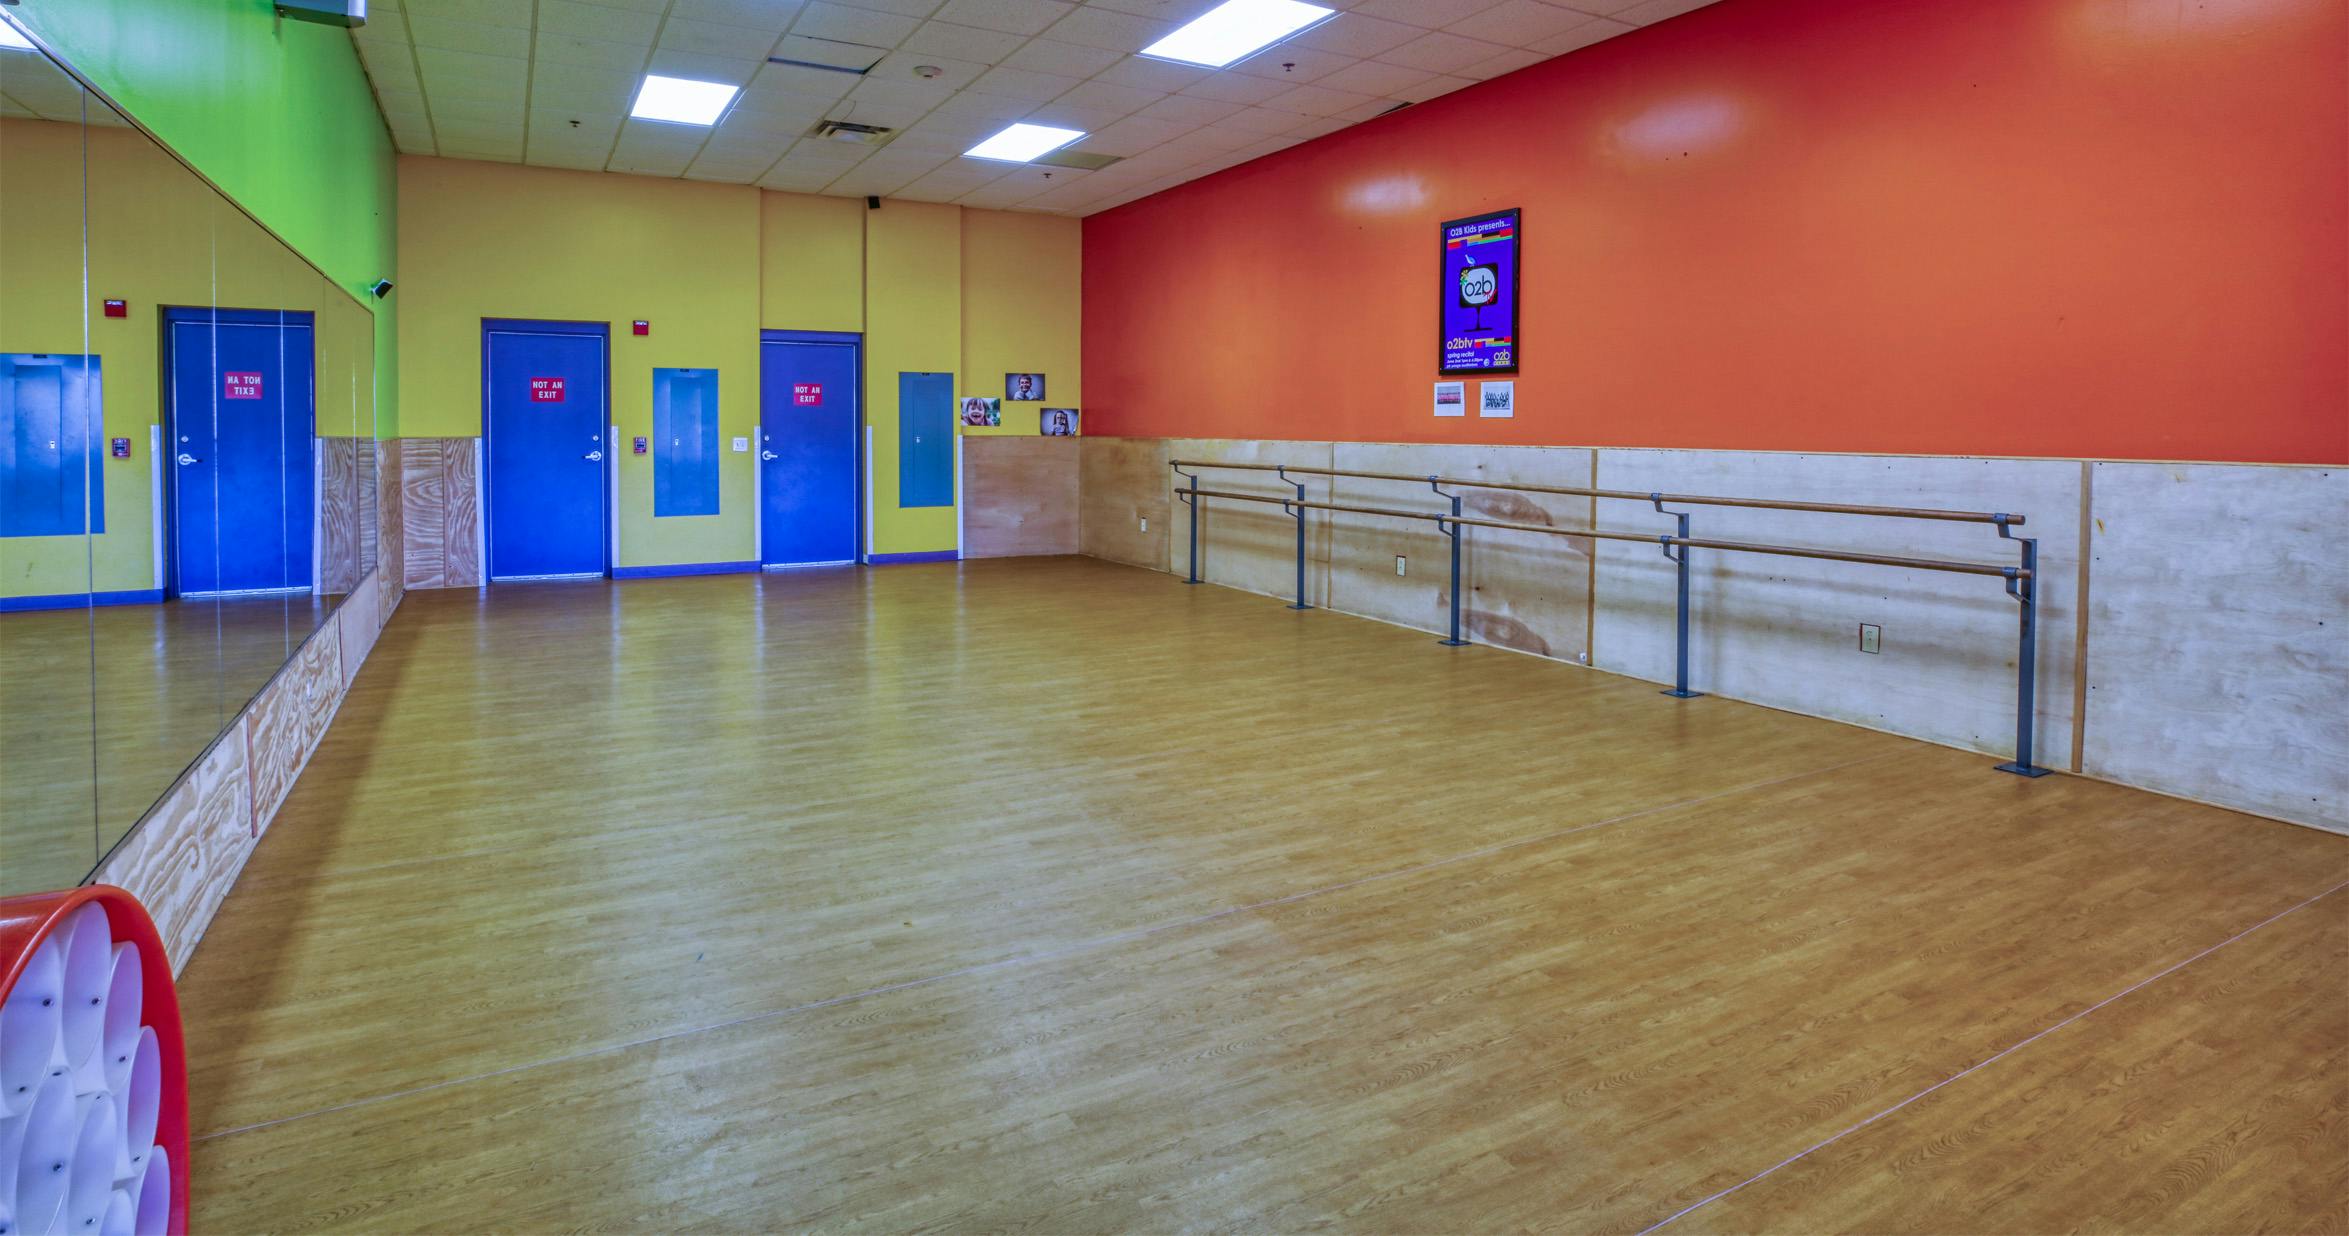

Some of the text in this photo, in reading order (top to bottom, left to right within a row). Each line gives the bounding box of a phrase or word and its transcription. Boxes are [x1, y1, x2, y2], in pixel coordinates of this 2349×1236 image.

[1450, 228, 1463, 237] O2B
[1464, 224, 1477, 234] Kids
[1465, 275, 1492, 296] o2b
[1447, 337, 1473, 349] o2btv
[1494, 348, 1510, 361] o2b
[533, 381, 562, 389] NOT AN
[538, 391, 557, 399] EXIT
